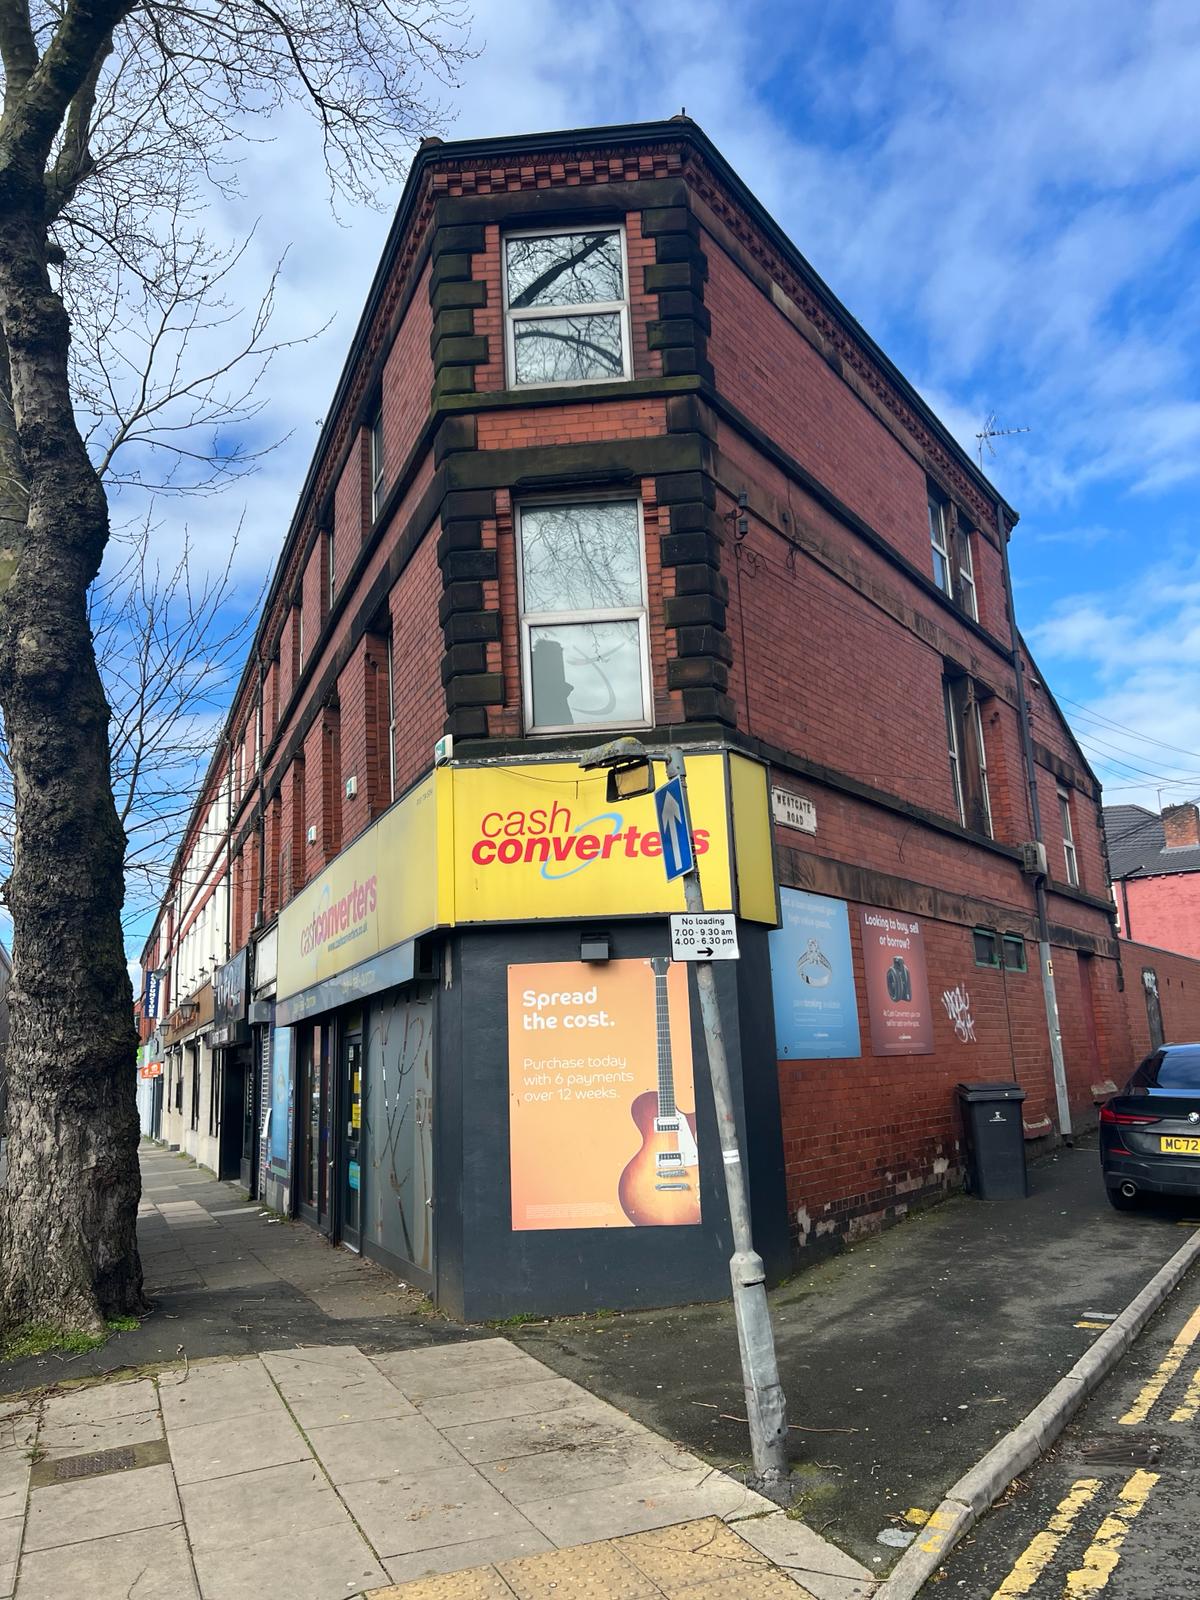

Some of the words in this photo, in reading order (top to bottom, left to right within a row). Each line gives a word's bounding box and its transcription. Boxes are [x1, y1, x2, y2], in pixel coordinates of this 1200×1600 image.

[776, 793, 811, 814] WESTGATE
[482, 800, 571, 838] cash
[786, 811, 804, 825] ROAD
[471, 825, 711, 866] convertes
[681, 917, 693, 925] No
[695, 917, 725, 926] loading
[864, 912, 889, 931] Looking
[889, 918, 896, 930] to
[896, 918, 909, 934] buy,
[909, 922, 920, 934] sell
[700, 928, 720, 936] 9.30
[701, 937, 721, 945] 6.30
[722, 938, 735, 946] pm
[879, 935, 886, 945] or
[886, 934, 910, 949] borrow?
[522, 986, 598, 1010] Spread
[523, 1012, 557, 1031] the
[563, 1011, 616, 1029] cost.
[523, 1056, 585, 1070] Purchase
[587, 1055, 627, 1070] today
[523, 1073, 552, 1087] with
[555, 1072, 564, 1084] 6
[567, 1071, 635, 1088] payments
[523, 1091, 553, 1102] over
[558, 1089, 571, 1101] 12
[575, 1087, 620, 1100] weeks.
[1165, 1138, 1199, 1151] MC72
